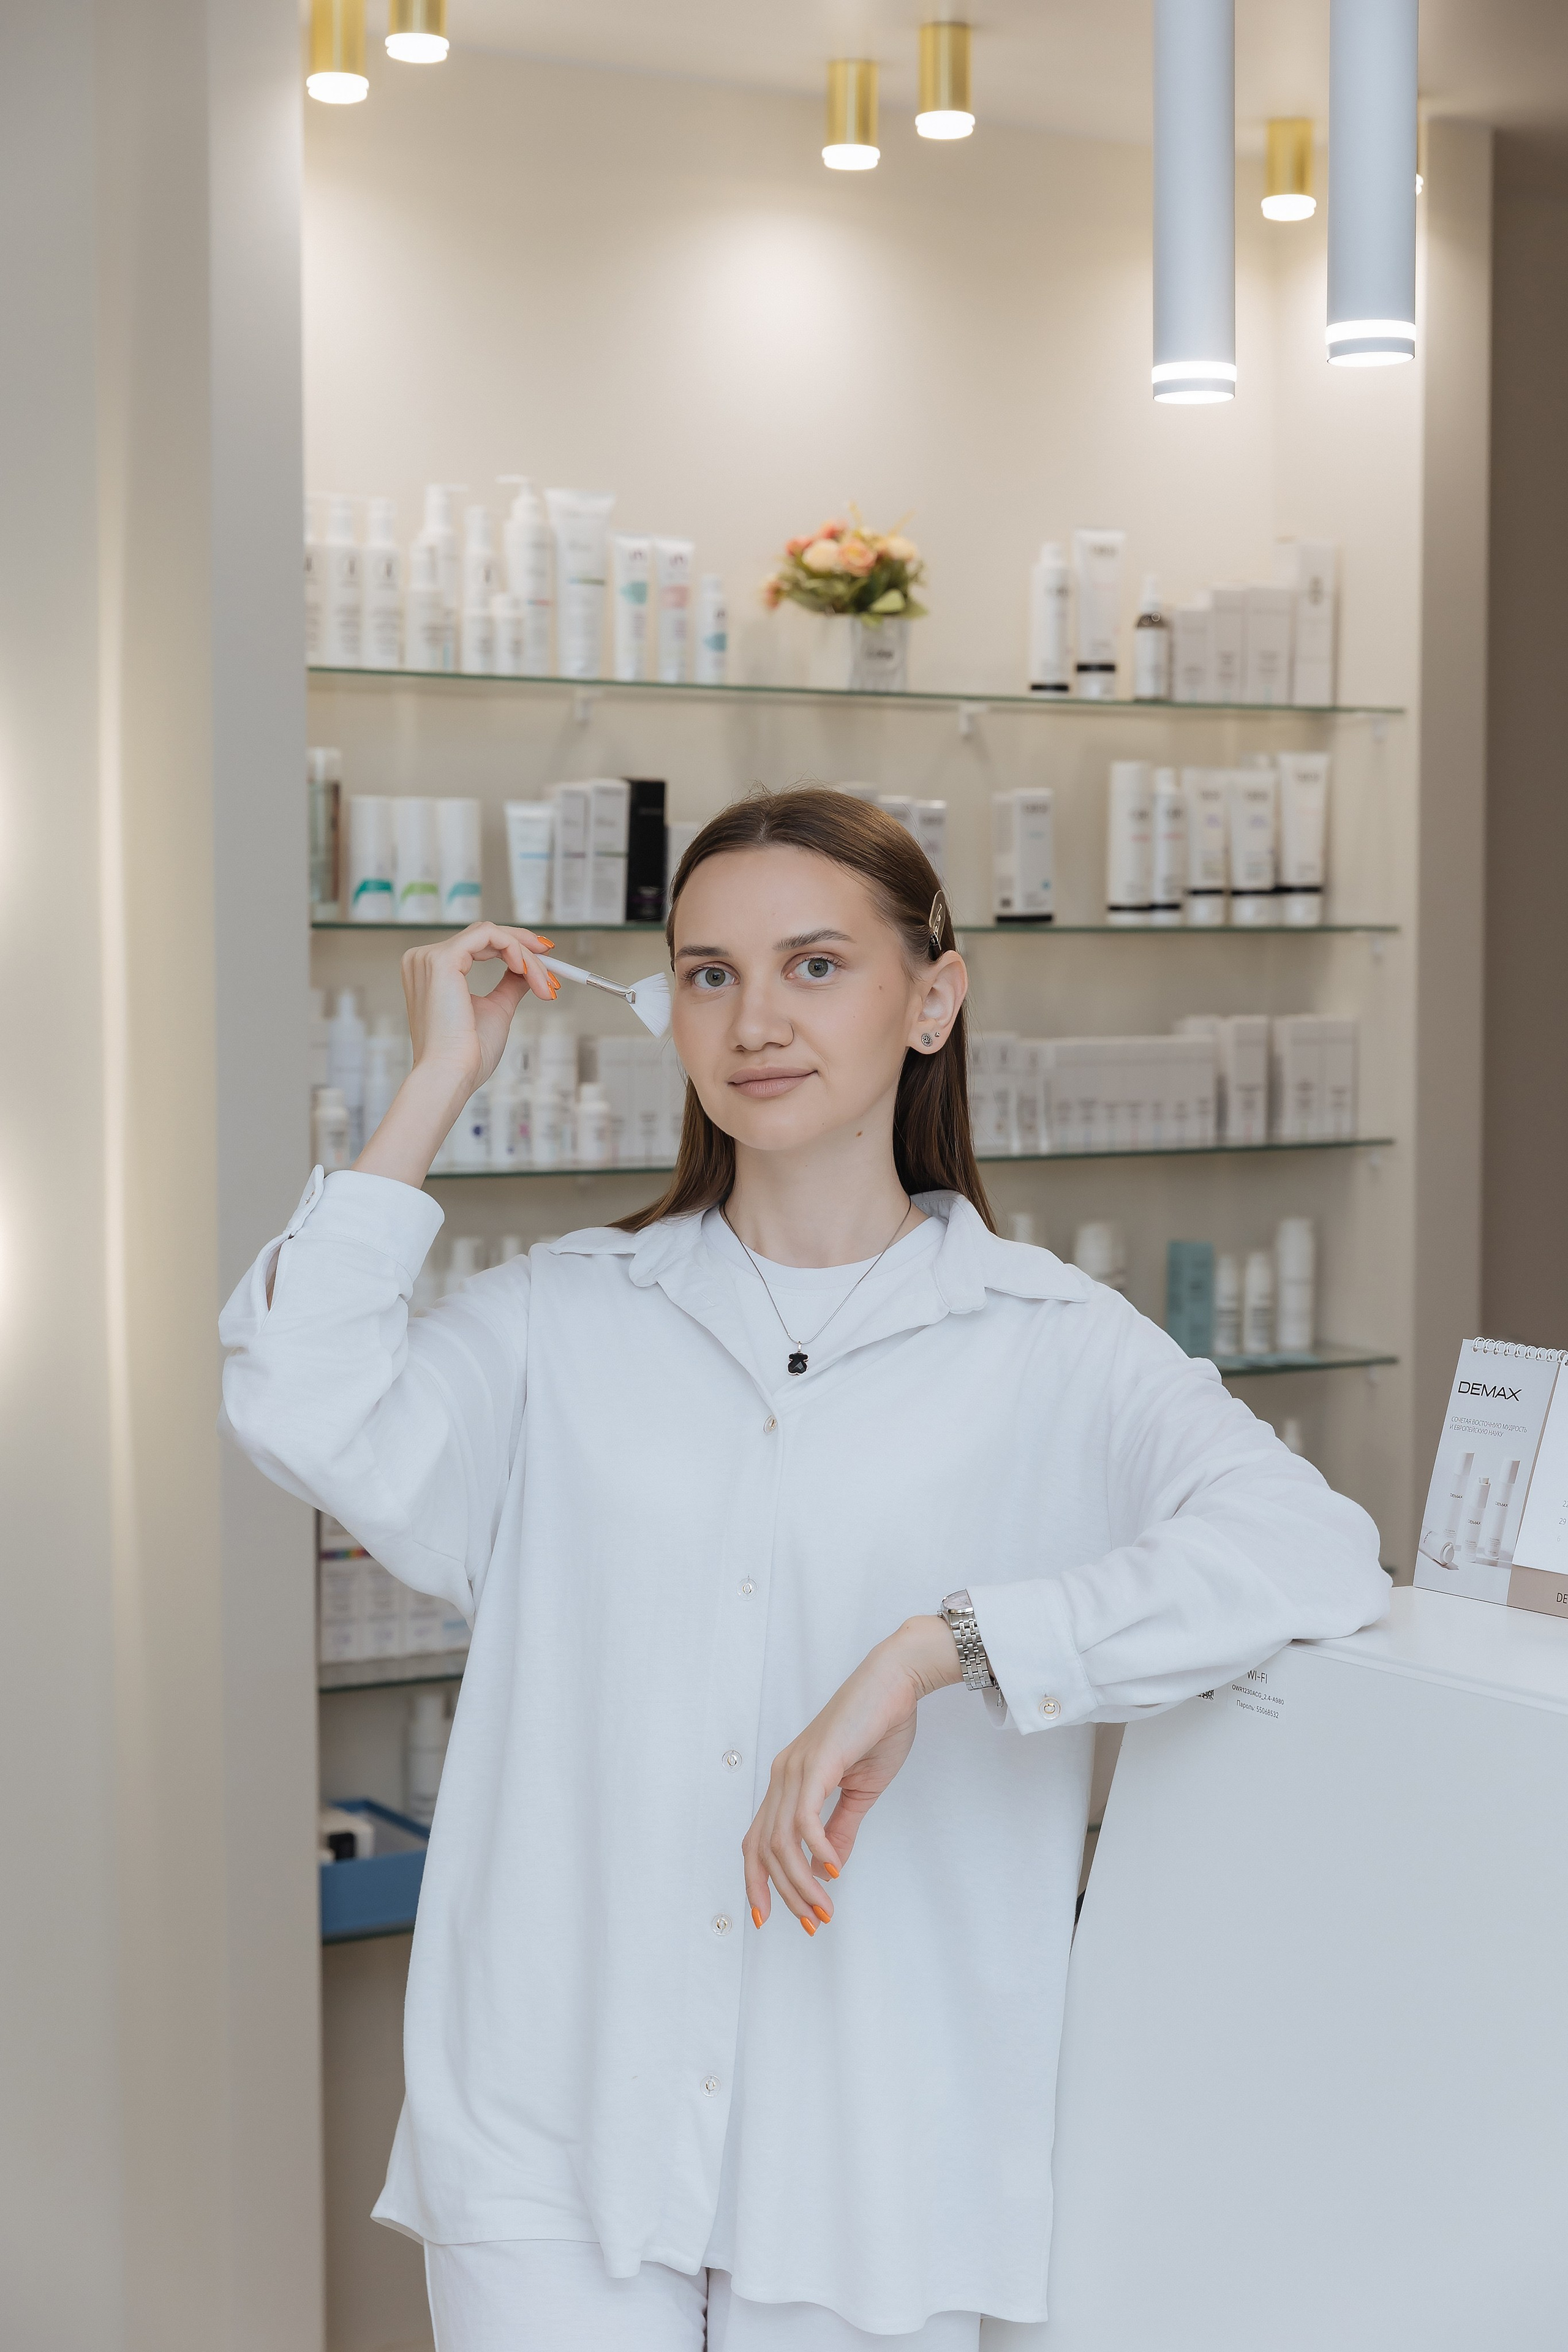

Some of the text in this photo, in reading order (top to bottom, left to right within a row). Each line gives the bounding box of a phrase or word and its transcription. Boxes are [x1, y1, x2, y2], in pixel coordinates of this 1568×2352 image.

[1458, 1381, 1522, 1401] DEMAX
[1453, 1424, 1488, 1435] ЕВРОПЕЙСКУЮ
[1472, 1419, 1502, 1429] ВОСТОЧНУЮ
[1502, 1423, 1528, 1433] МУДРОСТЬ
[1247, 1670, 1267, 1684] WI-FI
[1237, 1699, 1279, 1719] Пароль: 55068532
